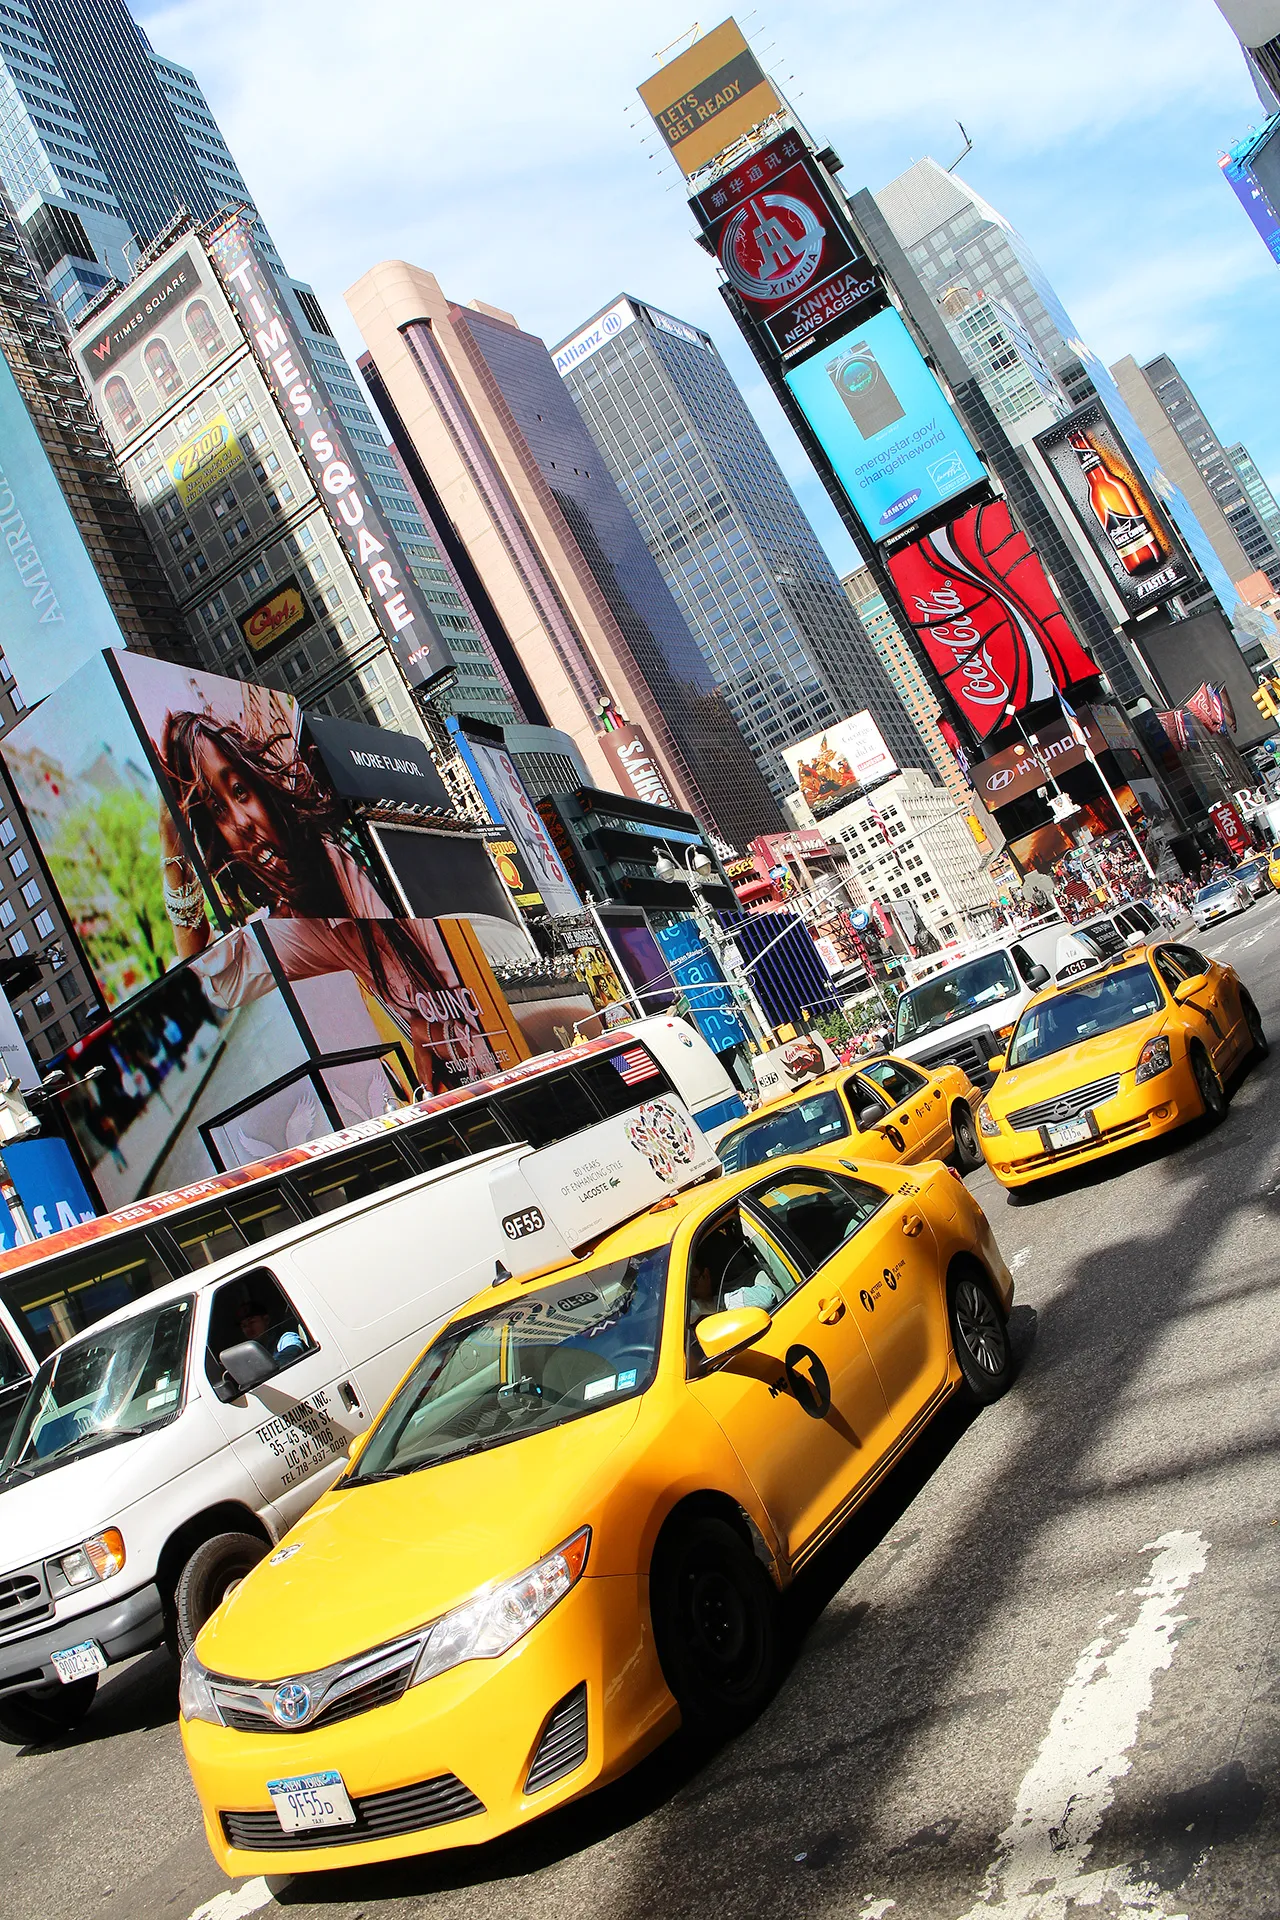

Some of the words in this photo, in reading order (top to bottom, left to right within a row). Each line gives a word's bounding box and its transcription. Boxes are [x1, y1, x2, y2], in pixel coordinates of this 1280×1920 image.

[659, 93, 699, 129] LET'S
[667, 114, 695, 142] GET
[696, 79, 742, 121] READY
[710, 139, 800, 208] 新华通讯社
[769, 252, 819, 296] XINHUA
[92, 335, 112, 362] W
[113, 313, 144, 344] TIMES
[145, 271, 188, 315] SQUARE
[784, 312, 824, 344] NEWS
[825, 275, 877, 319] AGENCY
[791, 273, 859, 324] XINHUA
[555, 329, 603, 372] Allianz
[228, 259, 313, 416] TIMES
[309, 429, 416, 634] SQUARE
[853, 417, 938, 477] energystar.gov/
[858, 429, 946, 490] changetheworld
[882, 492, 919, 520] SAMSUNG
[0, 464, 66, 625] AMERIC
[407, 645, 431, 667] NYC
[910, 584, 1010, 706] Coca-Cola
[350, 750, 385, 770] MORE
[385, 755, 425, 777] FLAVOR.
[616, 740, 672, 809] SHEY'S
[499, 754, 564, 883] CHICAGO
[1216, 807, 1238, 838] tkts
[496, 854, 524, 891] Q
[1065, 960, 1088, 976] 1C15
[560, 1186, 571, 1197] OF
[570, 1171, 607, 1193] ENHANCING
[605, 1159, 624, 1176] STYLE
[572, 1168, 583, 1178] 80
[581, 1158, 601, 1174] YEARS
[111, 1207, 152, 1224] FEEL
[147, 1192, 180, 1210] THE
[177, 1180, 221, 1199] HEAT.
[578, 1181, 609, 1203] LACOSTE
[504, 1210, 544, 1240] 9F55
[767, 1375, 789, 1399] NYC
[255, 1400, 314, 1445] TEITELBAUMS
[311, 1390, 332, 1410] INC.
[269, 1429, 300, 1457] 35-45
[298, 1417, 321, 1438] 35th
[318, 1408, 334, 1426] ST.
[281, 1471, 296, 1486] TEL
[295, 1435, 348, 1477] 718-937-0091
[284, 1449, 300, 1469] LIC
[299, 1440, 313, 1460] NY
[311, 1427, 334, 1451] 11106
[283, 1779, 302, 1792] NEW
[302, 1775, 325, 1789] YORK
